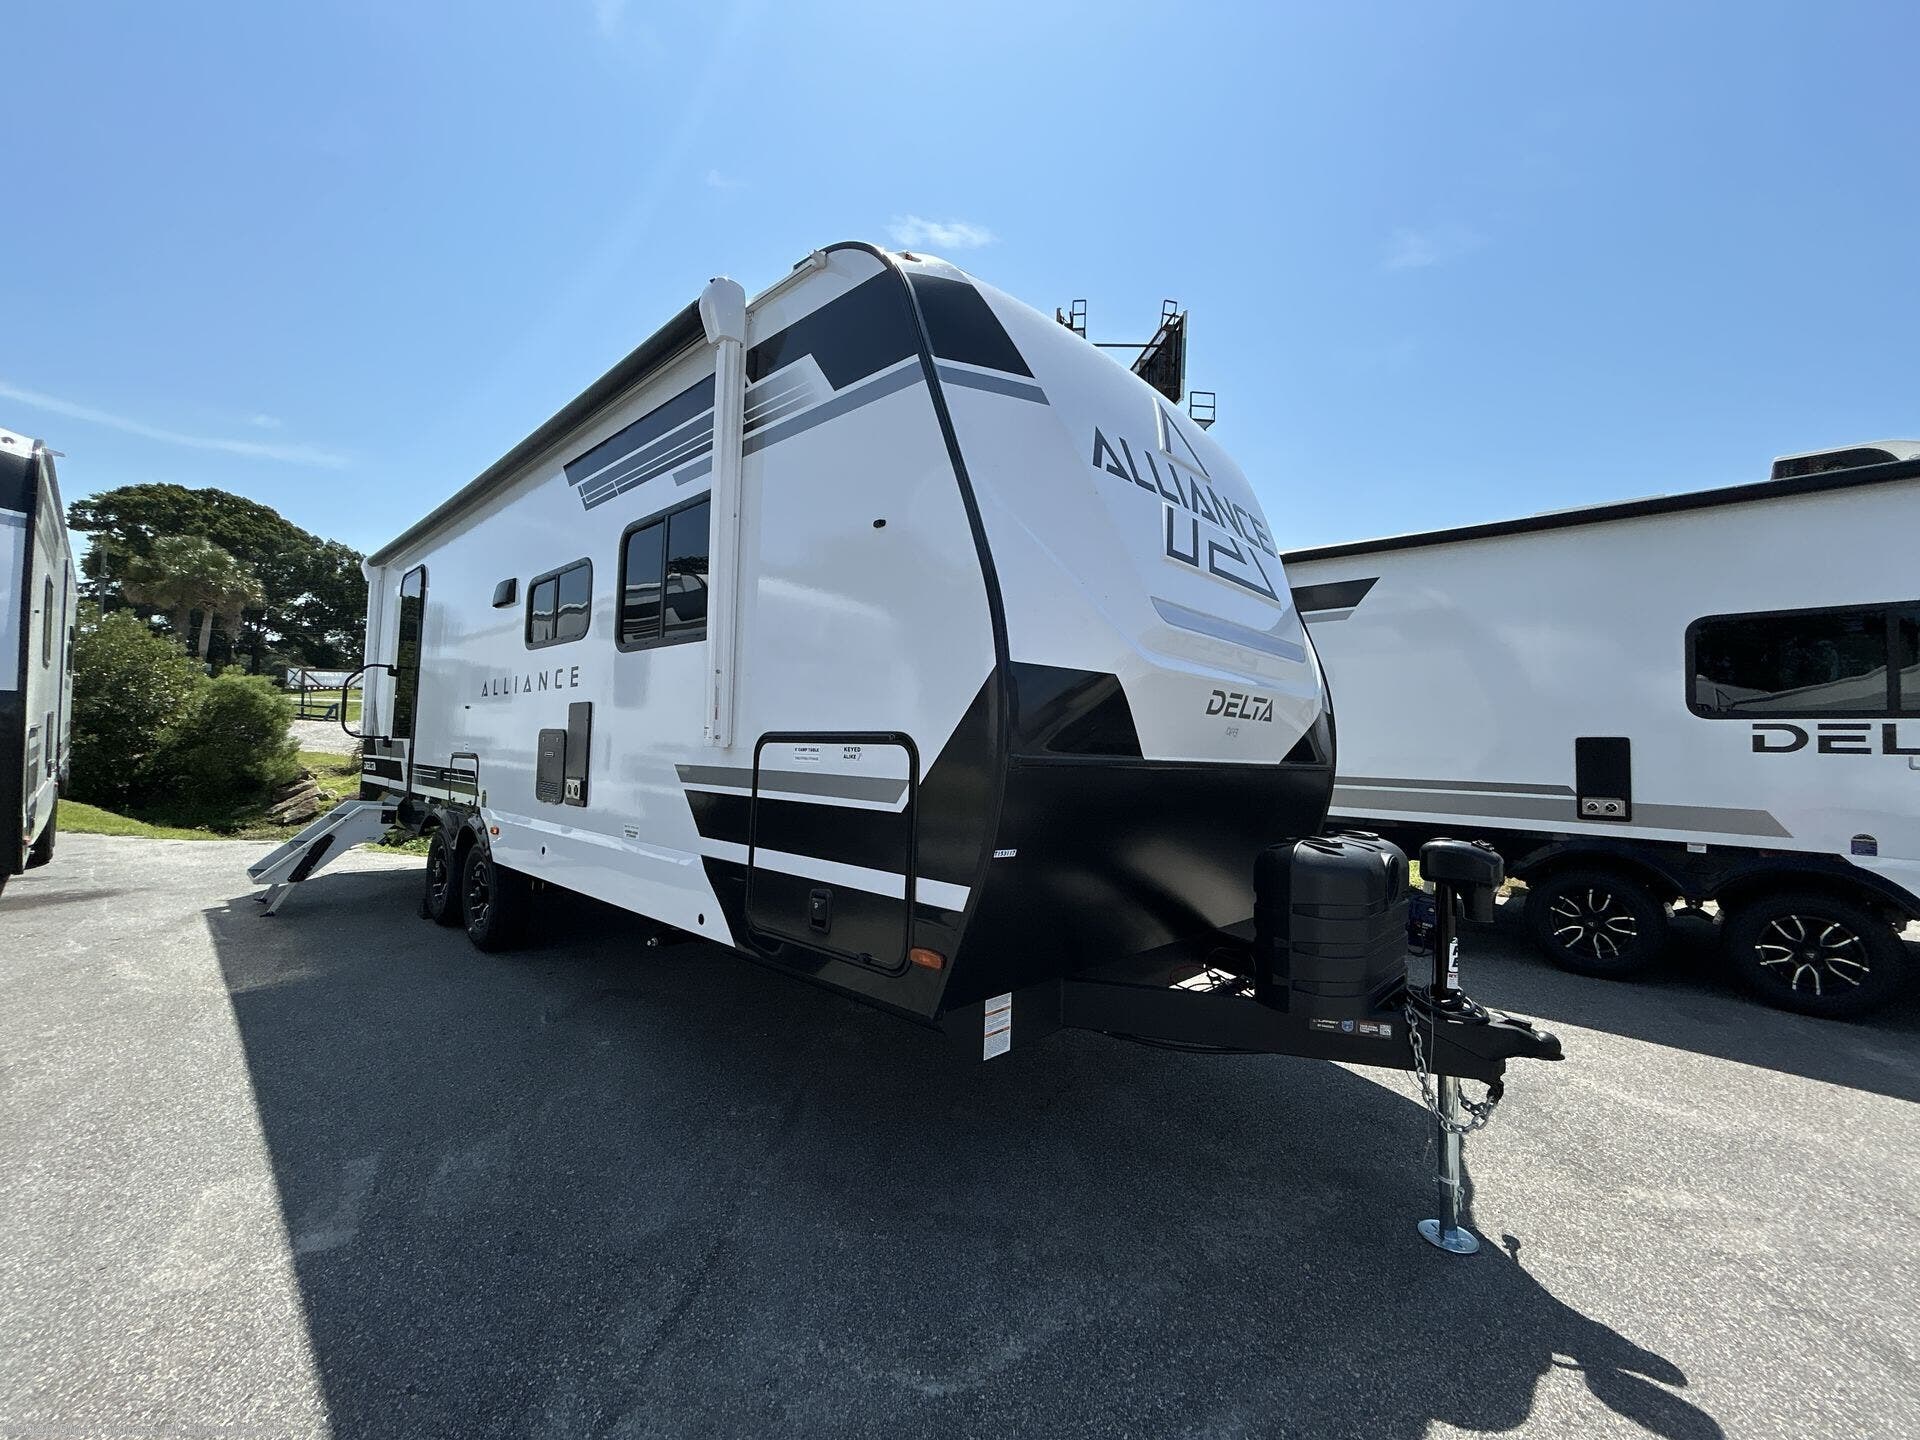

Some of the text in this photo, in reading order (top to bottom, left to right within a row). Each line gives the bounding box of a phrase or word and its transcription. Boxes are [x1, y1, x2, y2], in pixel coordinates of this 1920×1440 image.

[1092, 426, 1276, 559] ALLIANCE
[481, 666, 579, 697] ALLIANCE
[1205, 689, 1274, 722] DELTA
